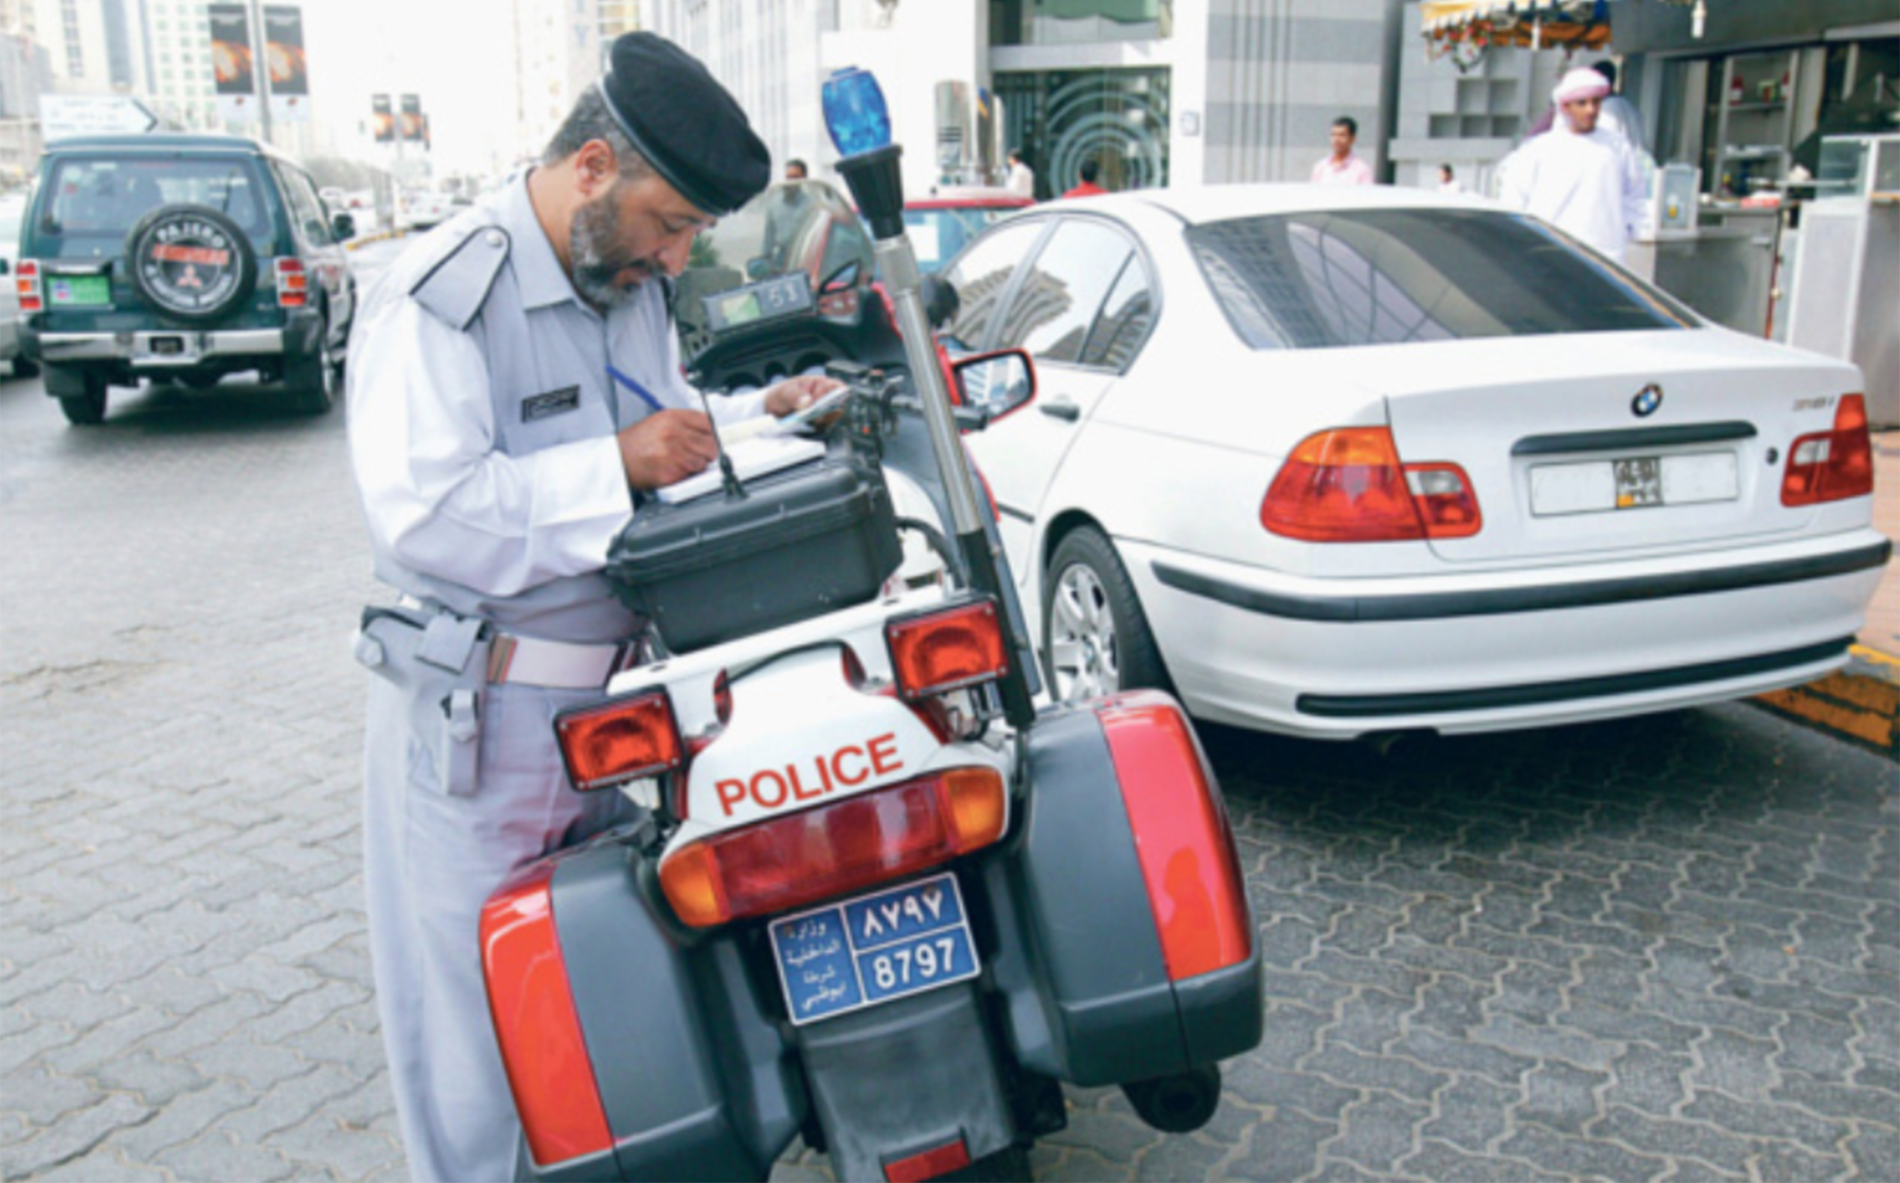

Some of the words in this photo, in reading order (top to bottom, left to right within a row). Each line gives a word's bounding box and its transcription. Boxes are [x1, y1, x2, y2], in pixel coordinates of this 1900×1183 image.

[157, 221, 225, 249] PAJERO
[714, 732, 904, 817] POLICE
[863, 889, 943, 938] ٨٧٩٧
[873, 938, 955, 989] 8797
